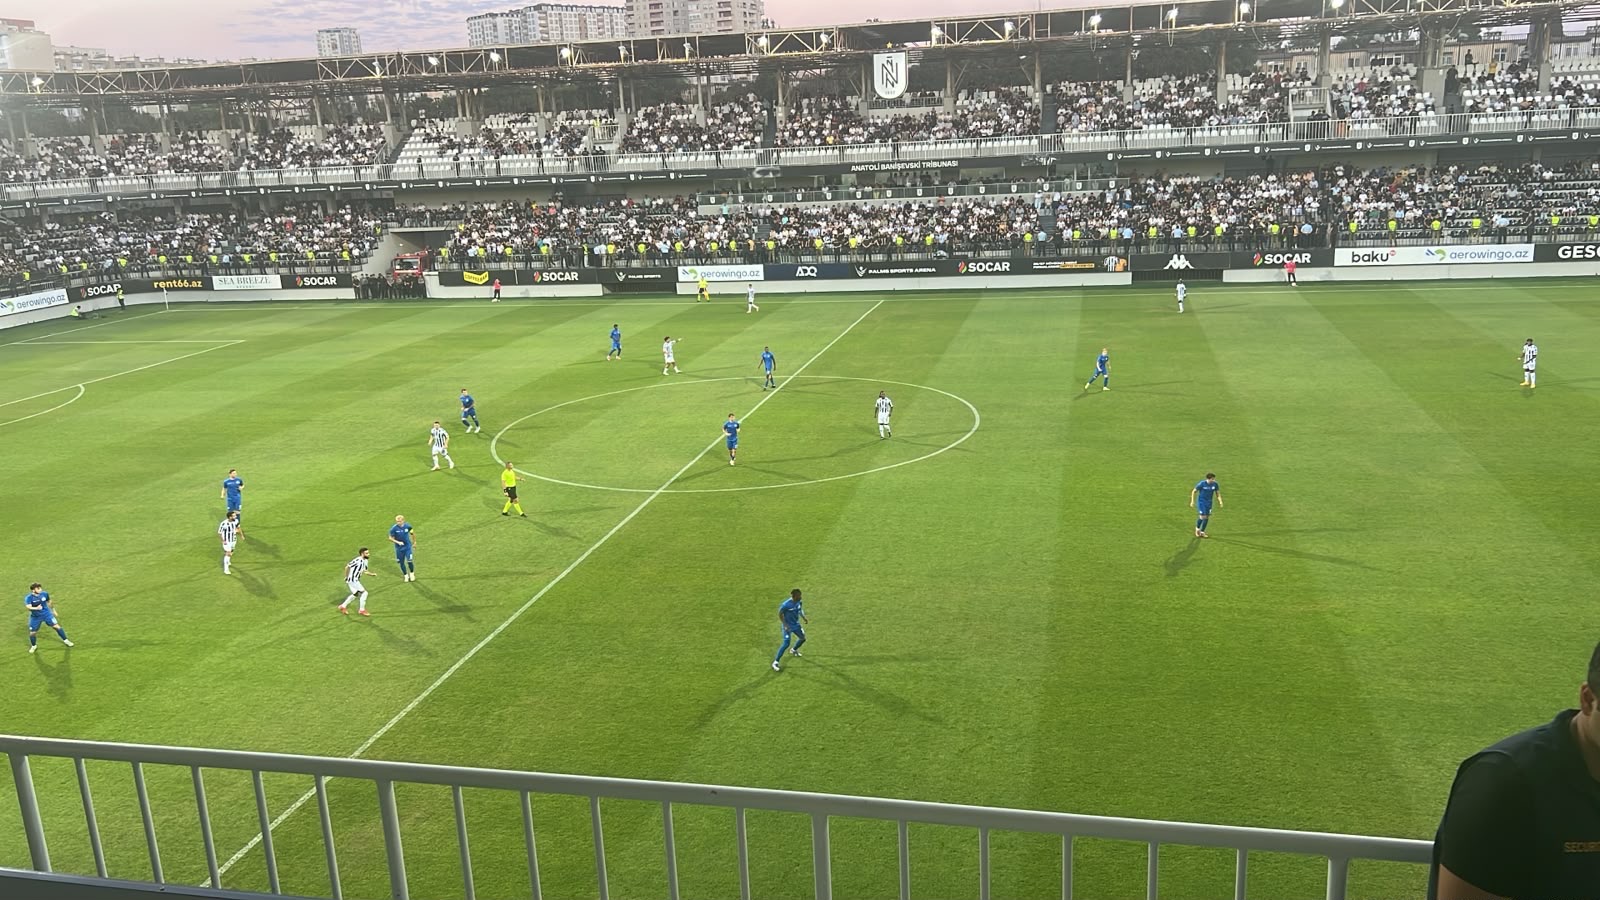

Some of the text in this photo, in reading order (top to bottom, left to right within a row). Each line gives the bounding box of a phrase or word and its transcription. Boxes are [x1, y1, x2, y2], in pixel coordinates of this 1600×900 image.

[1264, 252, 1312, 264] SOCAR
[1351, 251, 1389, 263] baku
[1450, 249, 1529, 261] aerowingo.az
[796, 266, 818, 277] ADQ
[968, 261, 1010, 272] SOCAR
[542, 272, 579, 281] SOCAR
[700, 268, 760, 279] aerowingo.az
[153, 279, 203, 289] rent66.az
[218, 275, 271, 285] SEA BREEZE
[303, 276, 337, 286] SOCAR
[16, 294, 66, 309] aerowingo.az
